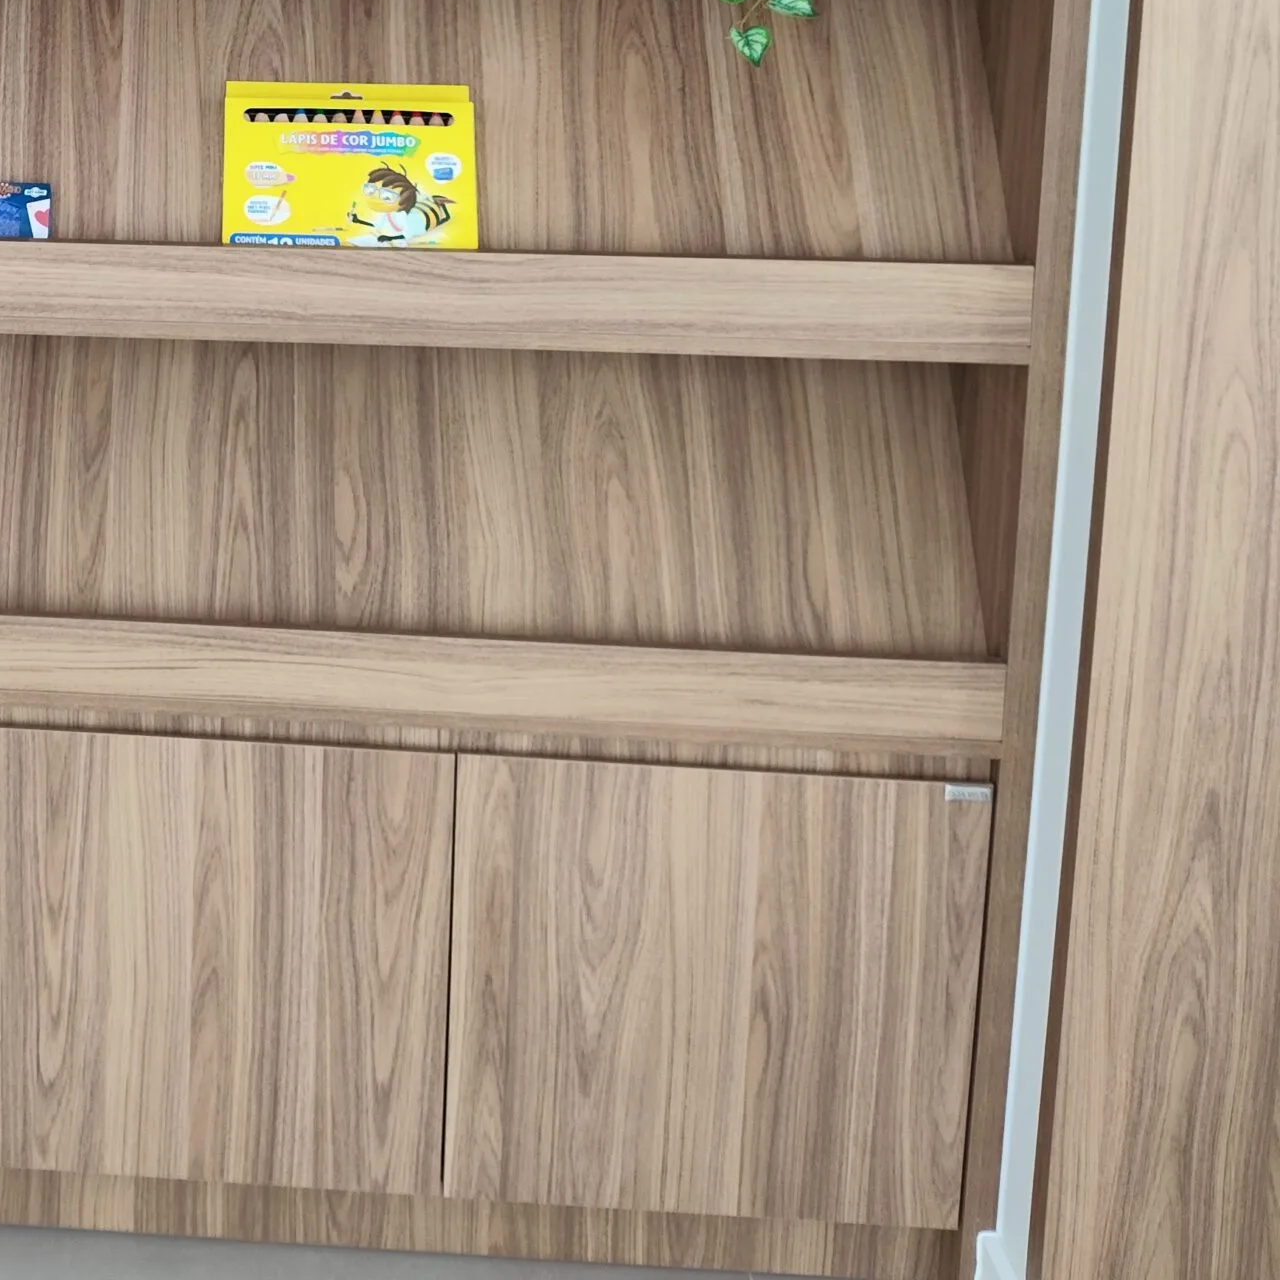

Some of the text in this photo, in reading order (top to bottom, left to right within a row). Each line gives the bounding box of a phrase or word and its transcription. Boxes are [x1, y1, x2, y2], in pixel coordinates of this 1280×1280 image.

[281, 131, 417, 148] LÁPIS DE COR JUMBO
[234, 234, 267, 245] CONTÉM
[295, 237, 336, 247] UNIDADES
